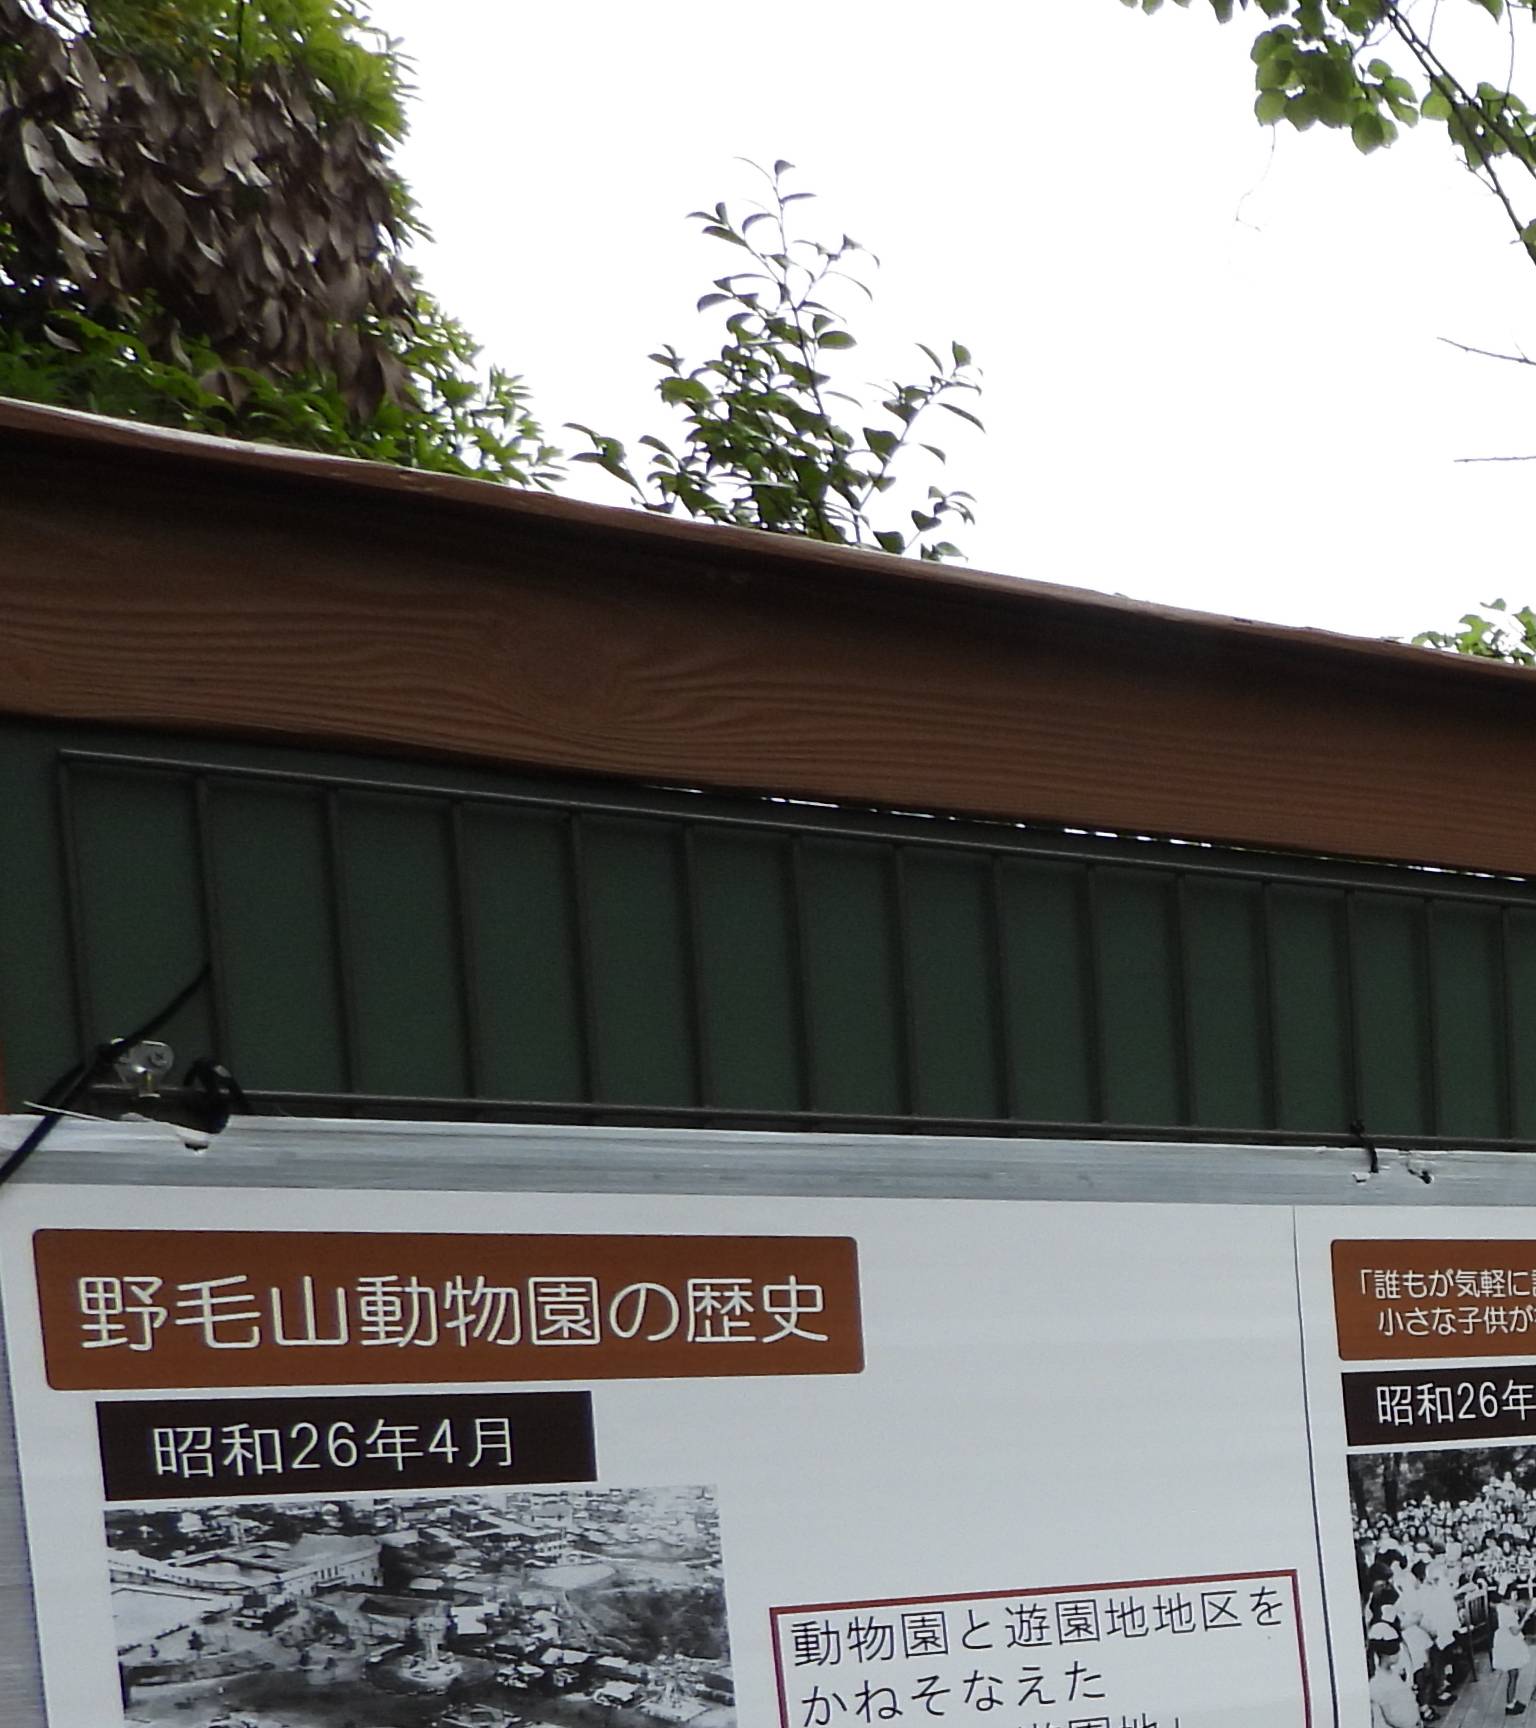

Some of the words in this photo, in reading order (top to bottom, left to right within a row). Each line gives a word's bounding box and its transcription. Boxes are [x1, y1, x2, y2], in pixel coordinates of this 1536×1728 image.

[77, 1275, 830, 1352] 野毛山動物園の歴史
[153, 1416, 515, 1479] 昭和26年4月
[791, 1586, 1285, 1669] 動物園と遊園地地区を
